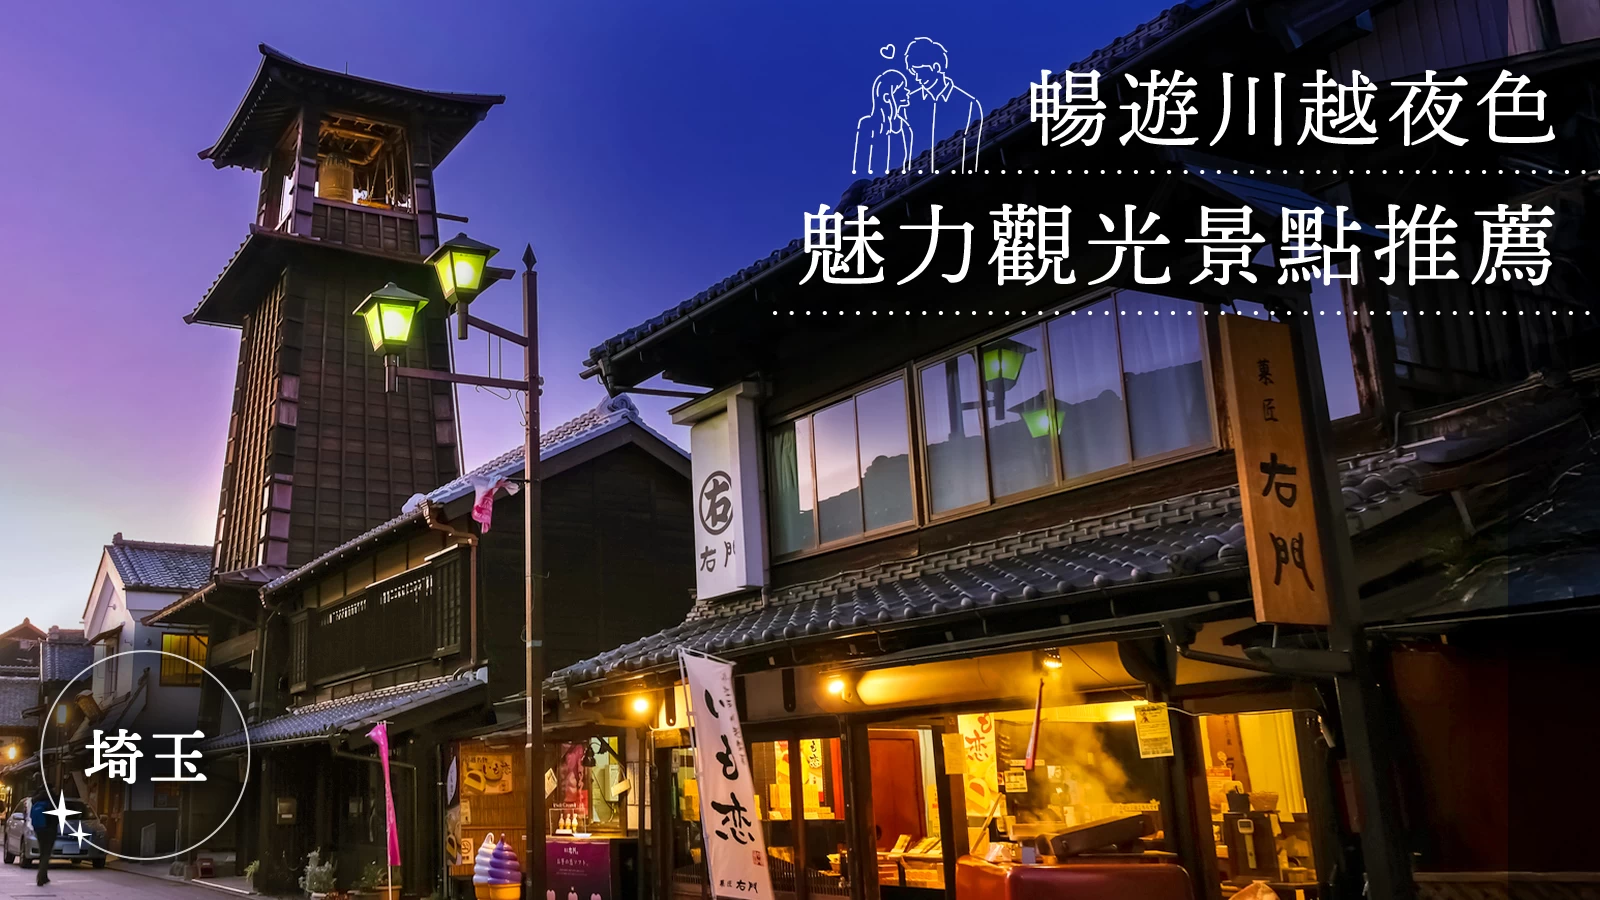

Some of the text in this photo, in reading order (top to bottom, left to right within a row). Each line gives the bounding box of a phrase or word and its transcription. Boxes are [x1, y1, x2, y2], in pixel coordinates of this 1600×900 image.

[1259, 452, 1315, 592] 右門
[704, 689, 756, 845] いも恋
